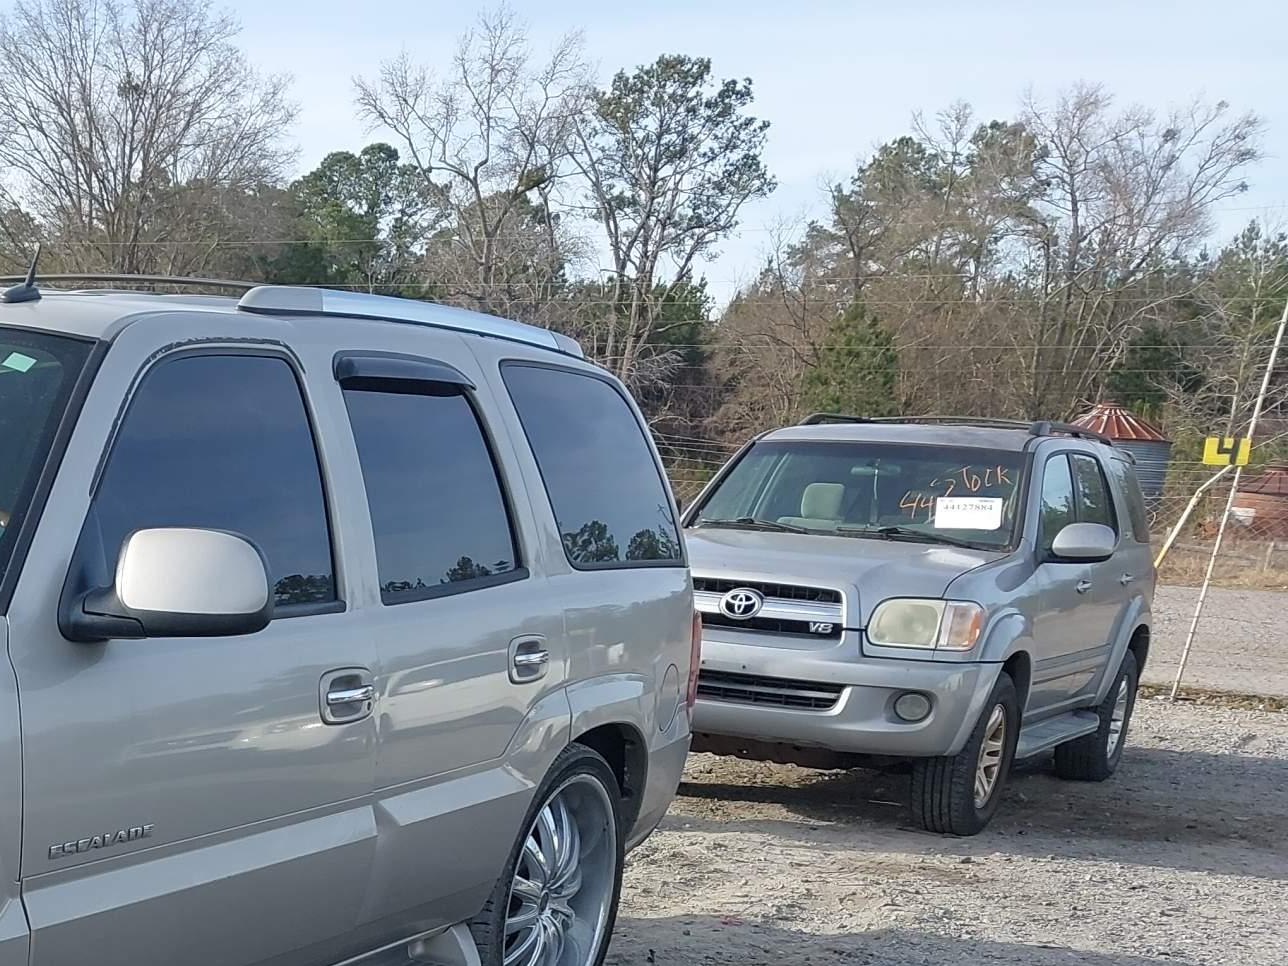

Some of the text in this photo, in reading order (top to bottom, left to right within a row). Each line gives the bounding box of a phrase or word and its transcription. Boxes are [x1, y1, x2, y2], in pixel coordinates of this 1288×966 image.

[1217, 437, 1241, 465] 4
[943, 502, 993, 511] 44127884
[809, 622, 833, 634] V8
[48, 823, 155, 860] ESCALADE
